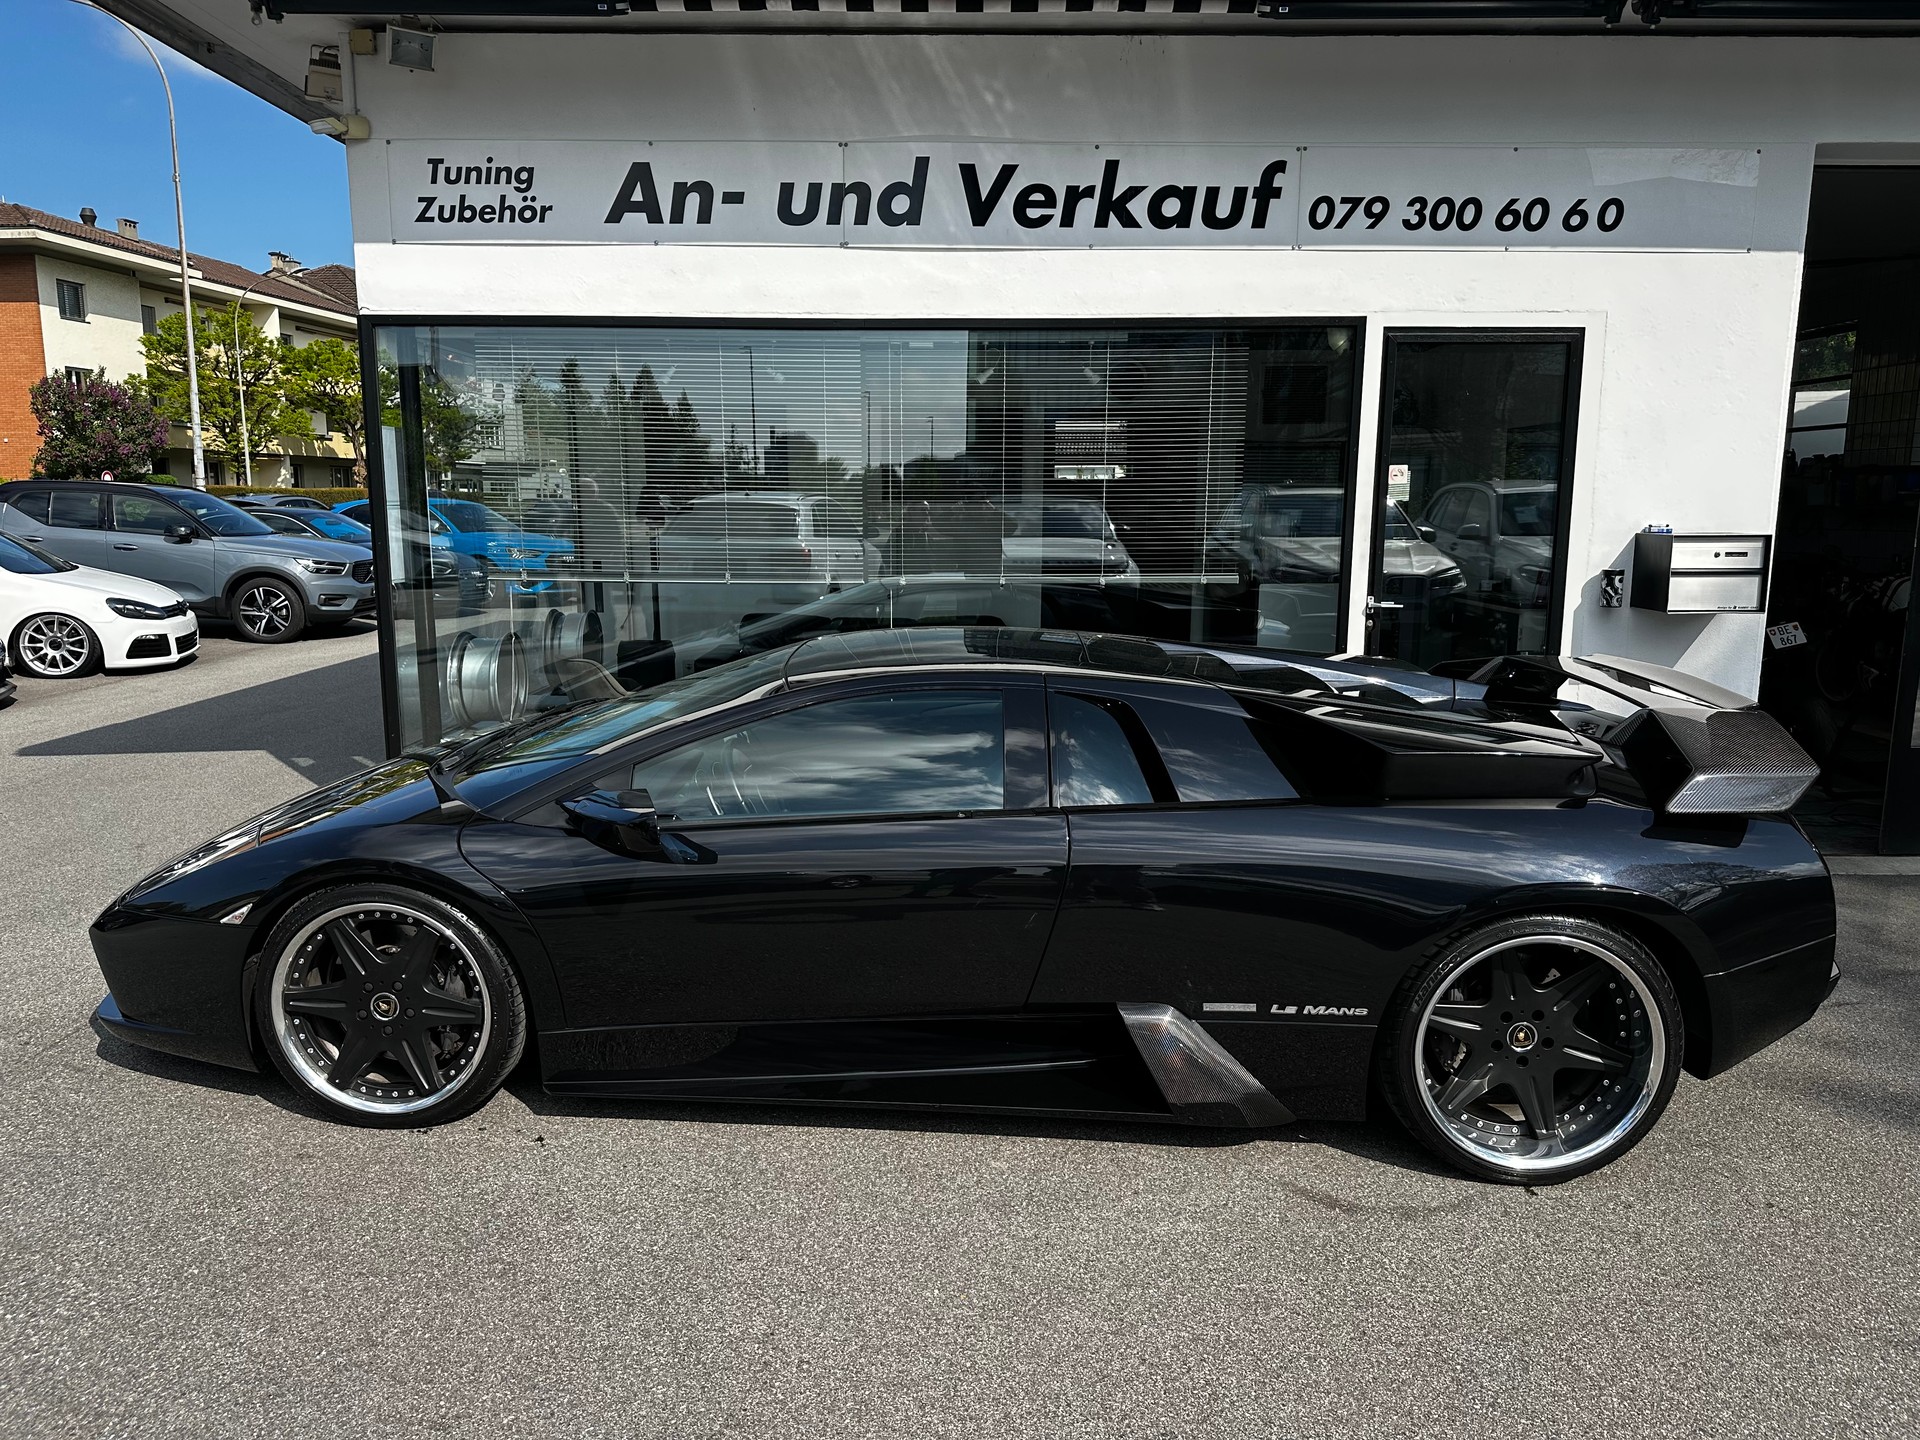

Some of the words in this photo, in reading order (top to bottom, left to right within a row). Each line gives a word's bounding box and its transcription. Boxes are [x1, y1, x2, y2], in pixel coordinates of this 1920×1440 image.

[428, 157, 534, 194] Tuning
[604, 162, 744, 225] An-
[778, 157, 930, 226] und
[955, 157, 1288, 230] Verkauf
[415, 195, 553, 224] Zubehör
[1309, 196, 1390, 231] 079
[1402, 196, 1482, 231] 300
[1495, 198, 1550, 232] 60
[1777, 625, 1792, 636] BE
[1780, 635, 1798, 646] 867
[1303, 1005, 1369, 1017] MANS
